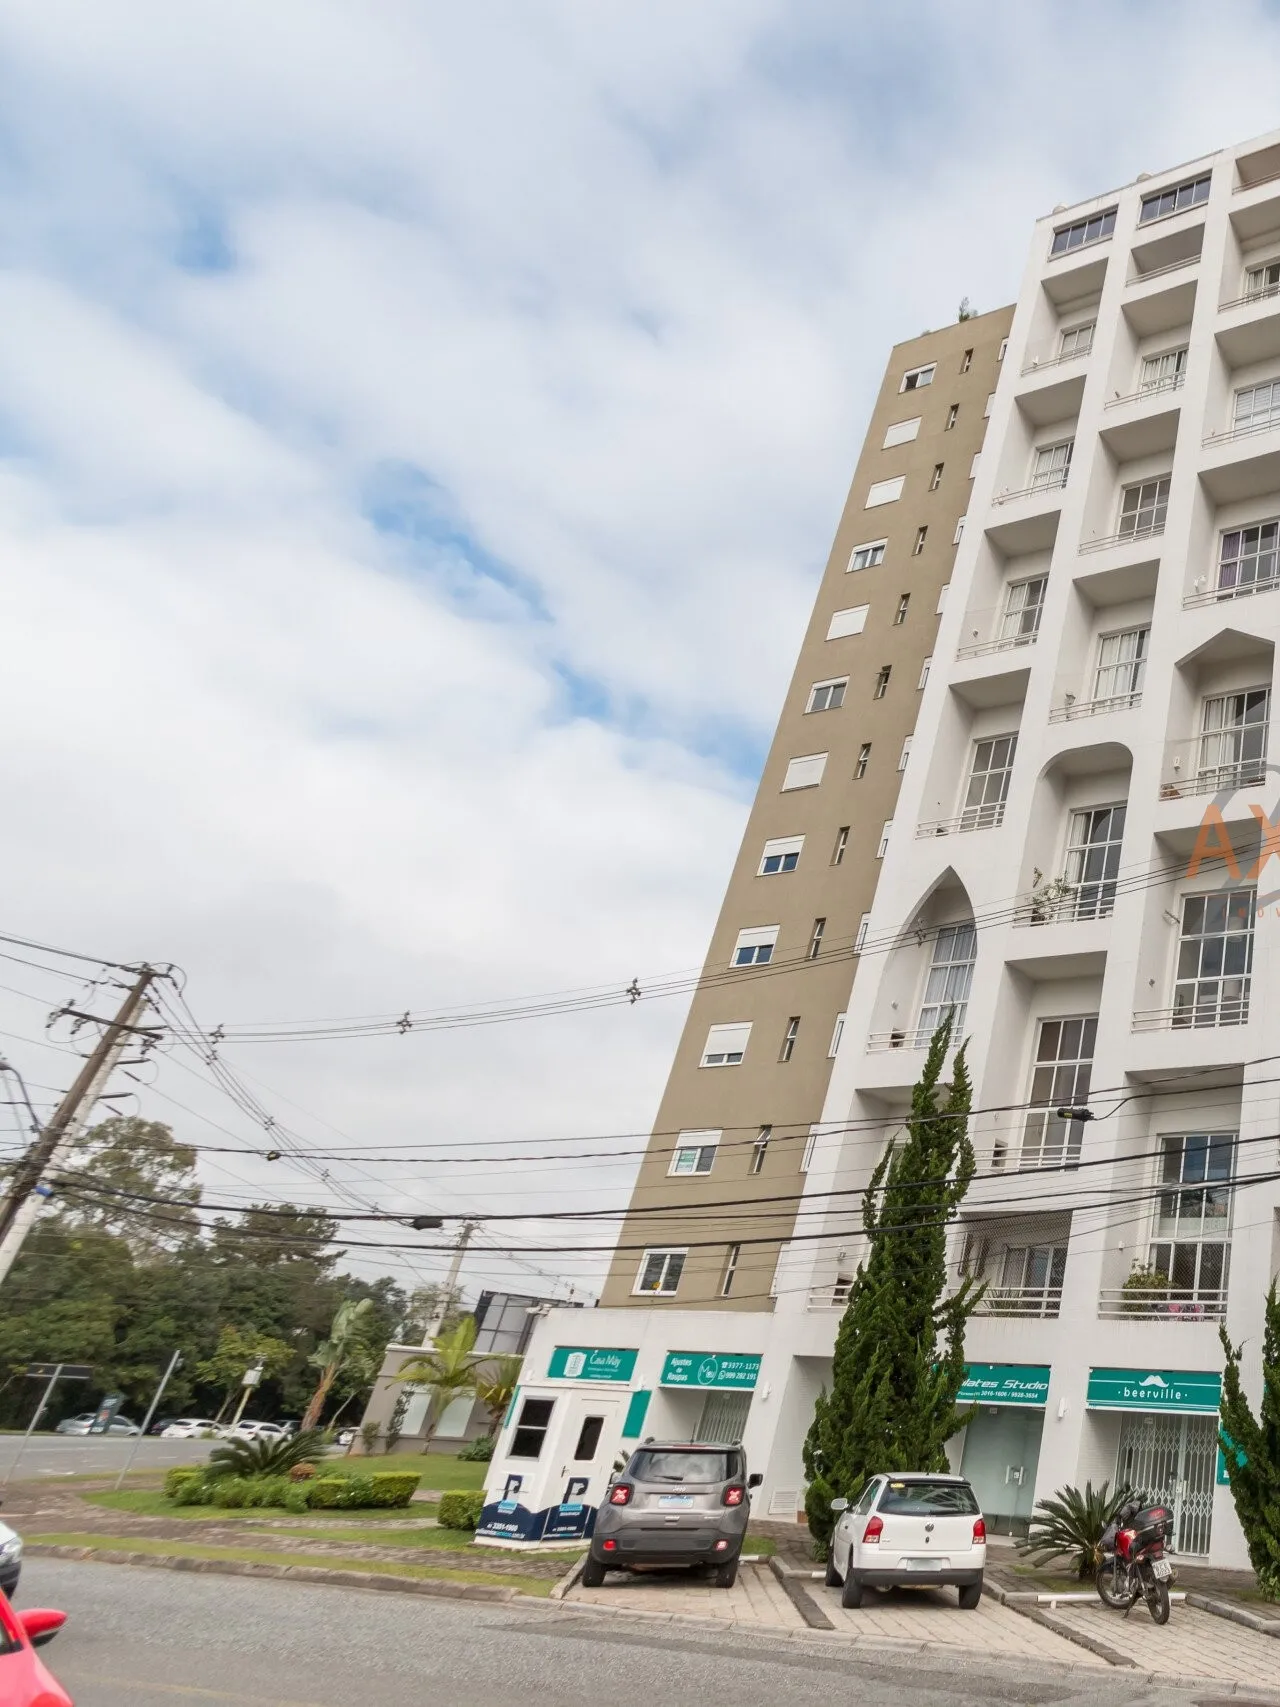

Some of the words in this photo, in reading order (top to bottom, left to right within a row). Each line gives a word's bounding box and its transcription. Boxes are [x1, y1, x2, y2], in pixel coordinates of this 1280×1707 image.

[961, 1379, 999, 1388] ilates
[1002, 1380, 1048, 1390] Studio
[1124, 1387, 1181, 1399] beerville
